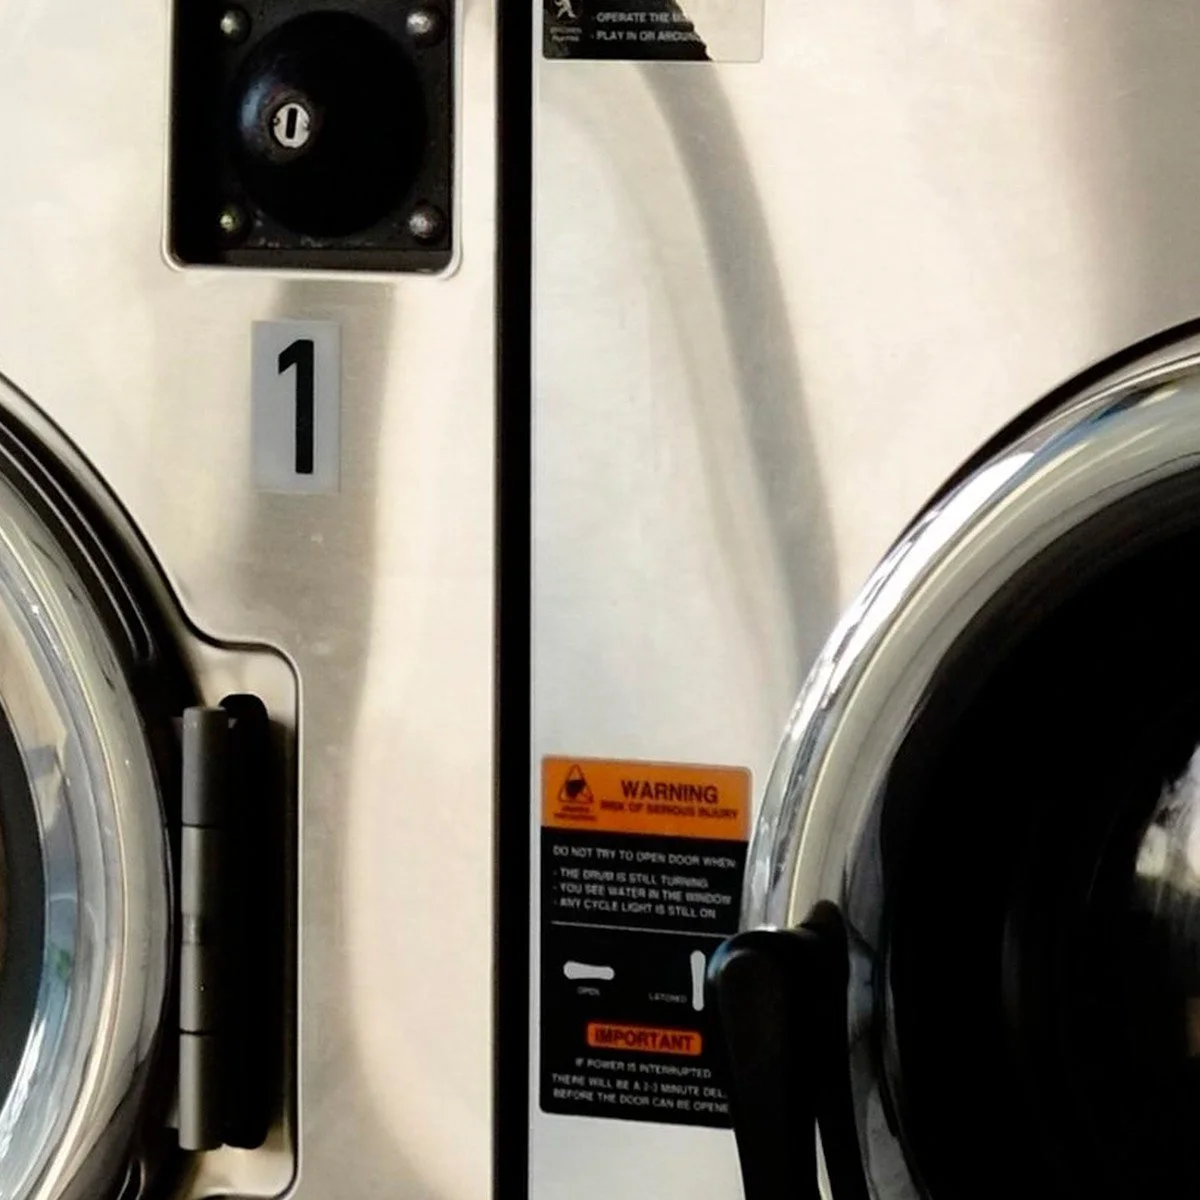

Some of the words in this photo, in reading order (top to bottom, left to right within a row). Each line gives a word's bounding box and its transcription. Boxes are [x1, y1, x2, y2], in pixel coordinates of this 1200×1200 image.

[596, 11, 646, 23] OPERATE
[650, 12, 670, 23] THE
[596, 29, 624, 41] PLAY
[626, 30, 638, 41] IN
[639, 30, 656, 42] OR
[657, 30, 702, 42] AROUN
[278, 339, 314, 474] 1
[620, 779, 719, 804] WARNING
[600, 800, 624, 811] RISK
[627, 802, 643, 813] OF
[646, 803, 696, 818] SERIOUS
[698, 806, 738, 819] INJURY
[552, 844, 569, 857] DO
[570, 846, 592, 859] NOT
[595, 848, 616, 860] TRY
[618, 849, 635, 862] TO
[635, 850, 666, 864] OPEN
[667, 852, 701, 866] DOOR
[560, 866, 580, 879] THE
[582, 869, 615, 881] DRUM
[615, 871, 627, 883] IS
[628, 872, 657, 886] STILL
[660, 874, 710, 890] TURNING
[559, 882, 583, 895] YOU
[584, 883, 606, 896] SEE
[607, 885, 646, 899] WATER
[647, 888, 660, 901] IN
[661, 889, 683, 902] THE
[684, 891, 733, 906] WINDOW
[560, 897, 581, 908] ANY
[583, 898, 619, 912] CYCLE
[620, 901, 653, 915] LIGHT
[653, 903, 666, 916] IS
[667, 904, 699, 919] STILL
[699, 907, 717, 919] ON
[595, 1028, 694, 1051] IMPORTANT
[574, 1056, 585, 1068] IF
[586, 1057, 625, 1073] POWER
[626, 1061, 637, 1073] IS
[639, 1062, 712, 1079] INTERRUPTED
[552, 1072, 586, 1087] THERE
[588, 1075, 614, 1090] WILL
[615, 1078, 630, 1092] BE
[632, 1079, 642, 1092] A
[660, 1082, 700, 1098] MINUTE
[702, 1086, 729, 1100] DEL
[552, 1086, 595, 1103] BEFORE
[597, 1090, 618, 1104] THE
[619, 1093, 650, 1107] DOOR
[651, 1095, 675, 1110] CAN
[676, 1098, 692, 1112] BE
[692, 1100, 731, 1115] OPENE
